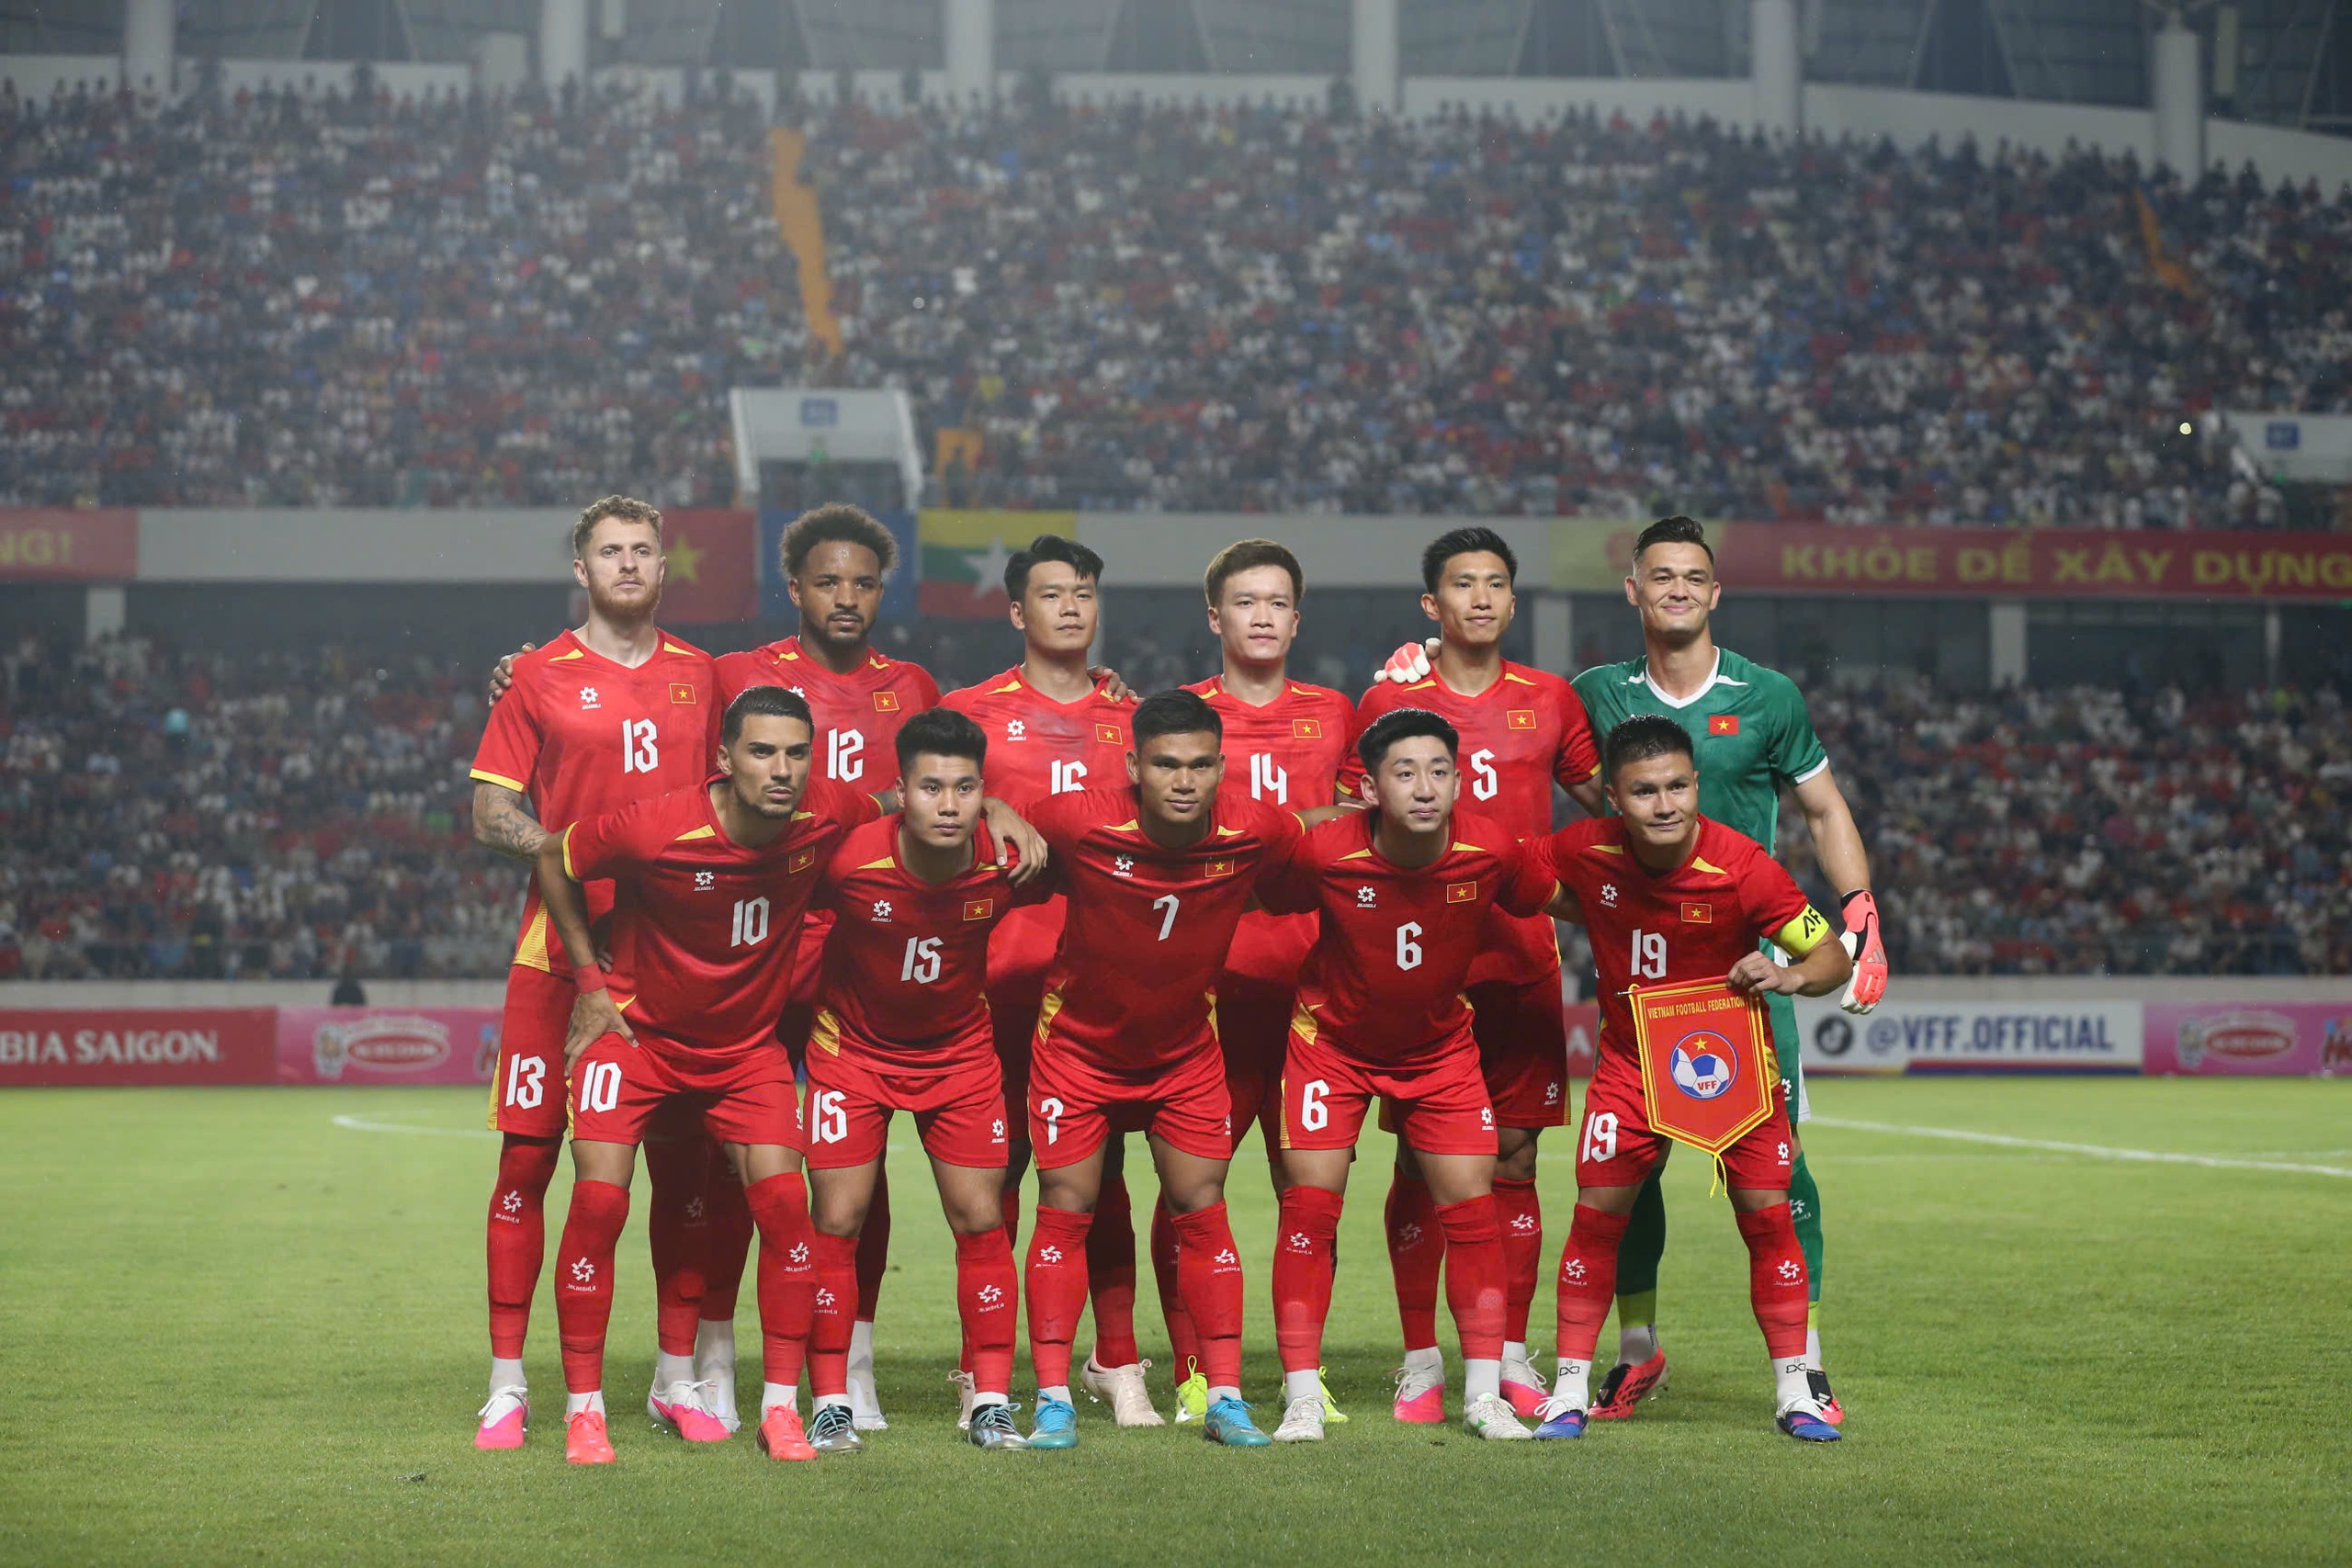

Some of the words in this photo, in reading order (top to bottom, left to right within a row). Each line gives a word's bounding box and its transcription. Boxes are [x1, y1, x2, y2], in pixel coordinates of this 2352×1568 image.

[622, 718, 659, 773] 13
[827, 728, 865, 782] 12
[1250, 752, 1287, 806] 14
[1470, 748, 1498, 802] 5
[730, 896, 770, 948] 10
[1153, 894, 1181, 942] 7
[900, 936, 944, 984] 15
[1396, 920, 1423, 971] 6
[1631, 929, 1667, 979] 19
[1647, 1004, 1675, 1020] VIETNAM
[1675, 1001, 1707, 1016] FOOTBALL
[1707, 996, 1746, 1011] FEDERATION
[0, 1030, 67, 1065] BIA
[74, 1029, 220, 1064] SAIGON
[1867, 1014, 2115, 1056] @VFF.OFFICIAL
[505, 1053, 547, 1110] 13
[580, 1060, 623, 1113] 10
[1301, 1079, 1330, 1132] 6
[1697, 1080, 1718, 1091] VFF
[811, 1089, 848, 1145] 15
[1582, 1111, 1619, 1163] 19
